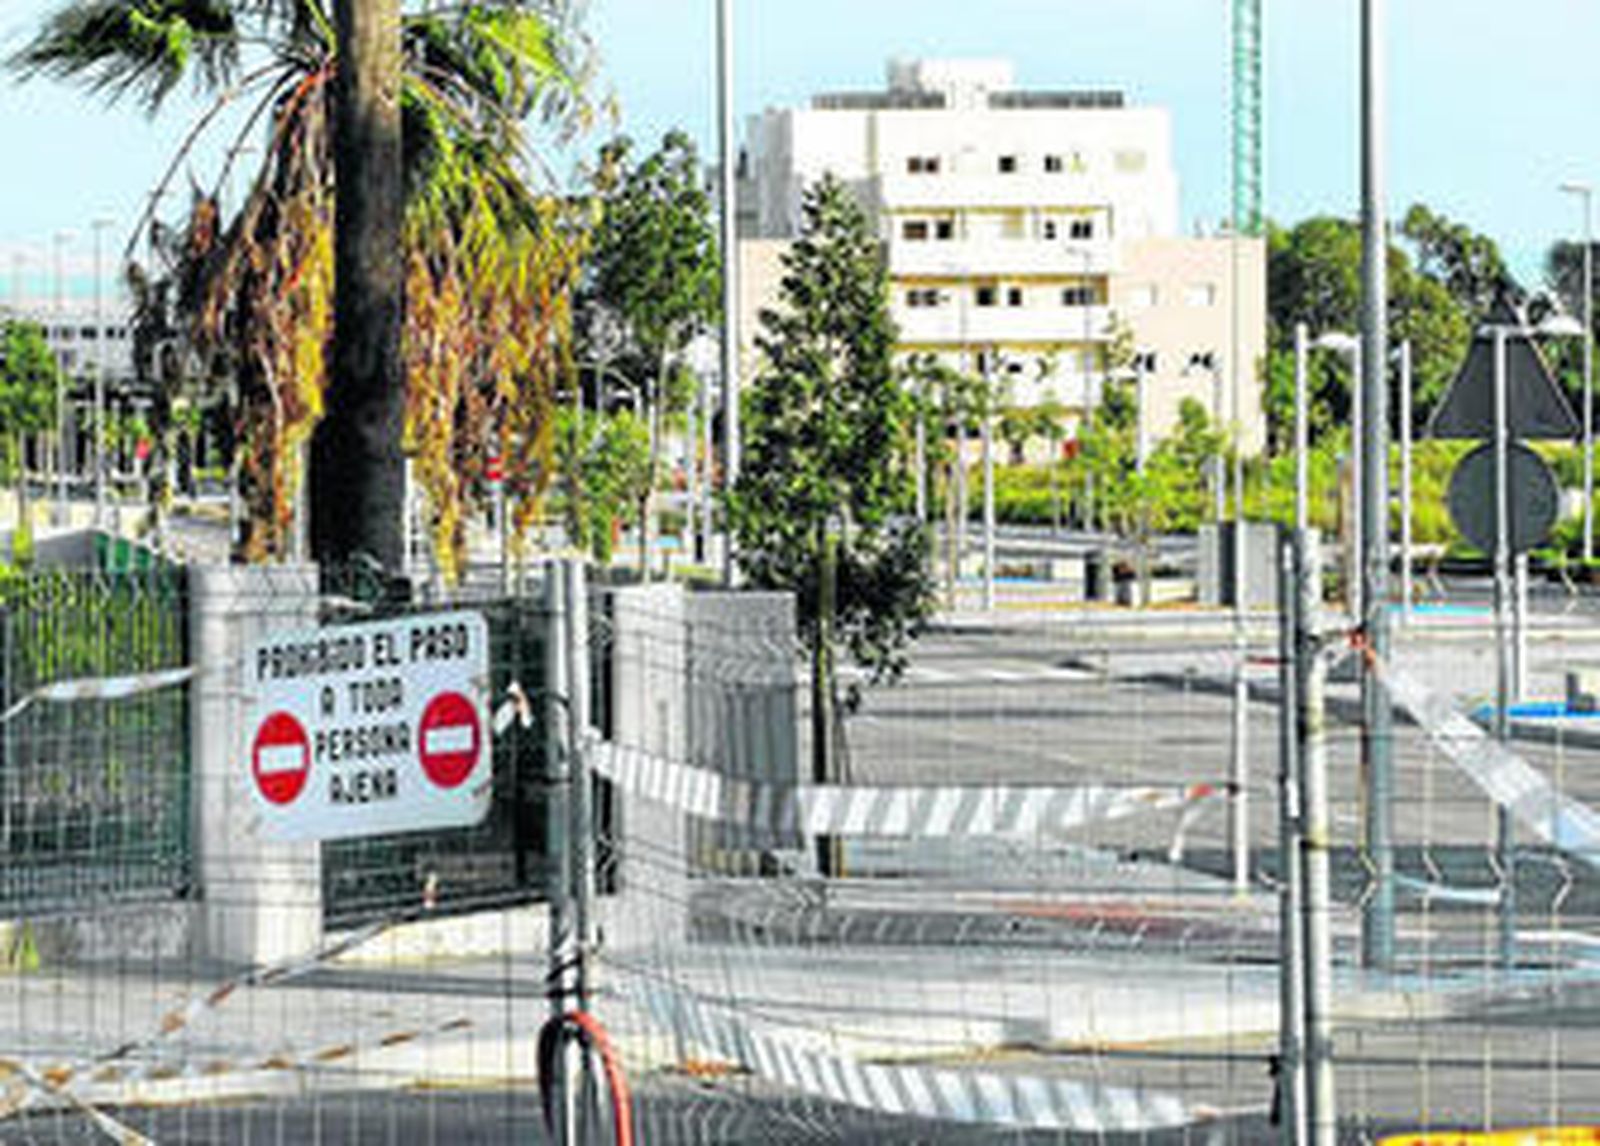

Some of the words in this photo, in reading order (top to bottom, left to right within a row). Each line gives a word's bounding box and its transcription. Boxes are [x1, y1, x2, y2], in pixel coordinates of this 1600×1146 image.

[374, 633, 400, 666] EL
[411, 623, 468, 662] PASO
[321, 685, 334, 716] A
[349, 677, 401, 714] TODA
[315, 722, 410, 763] PERSONA
[331, 769, 397, 803] AJENA
